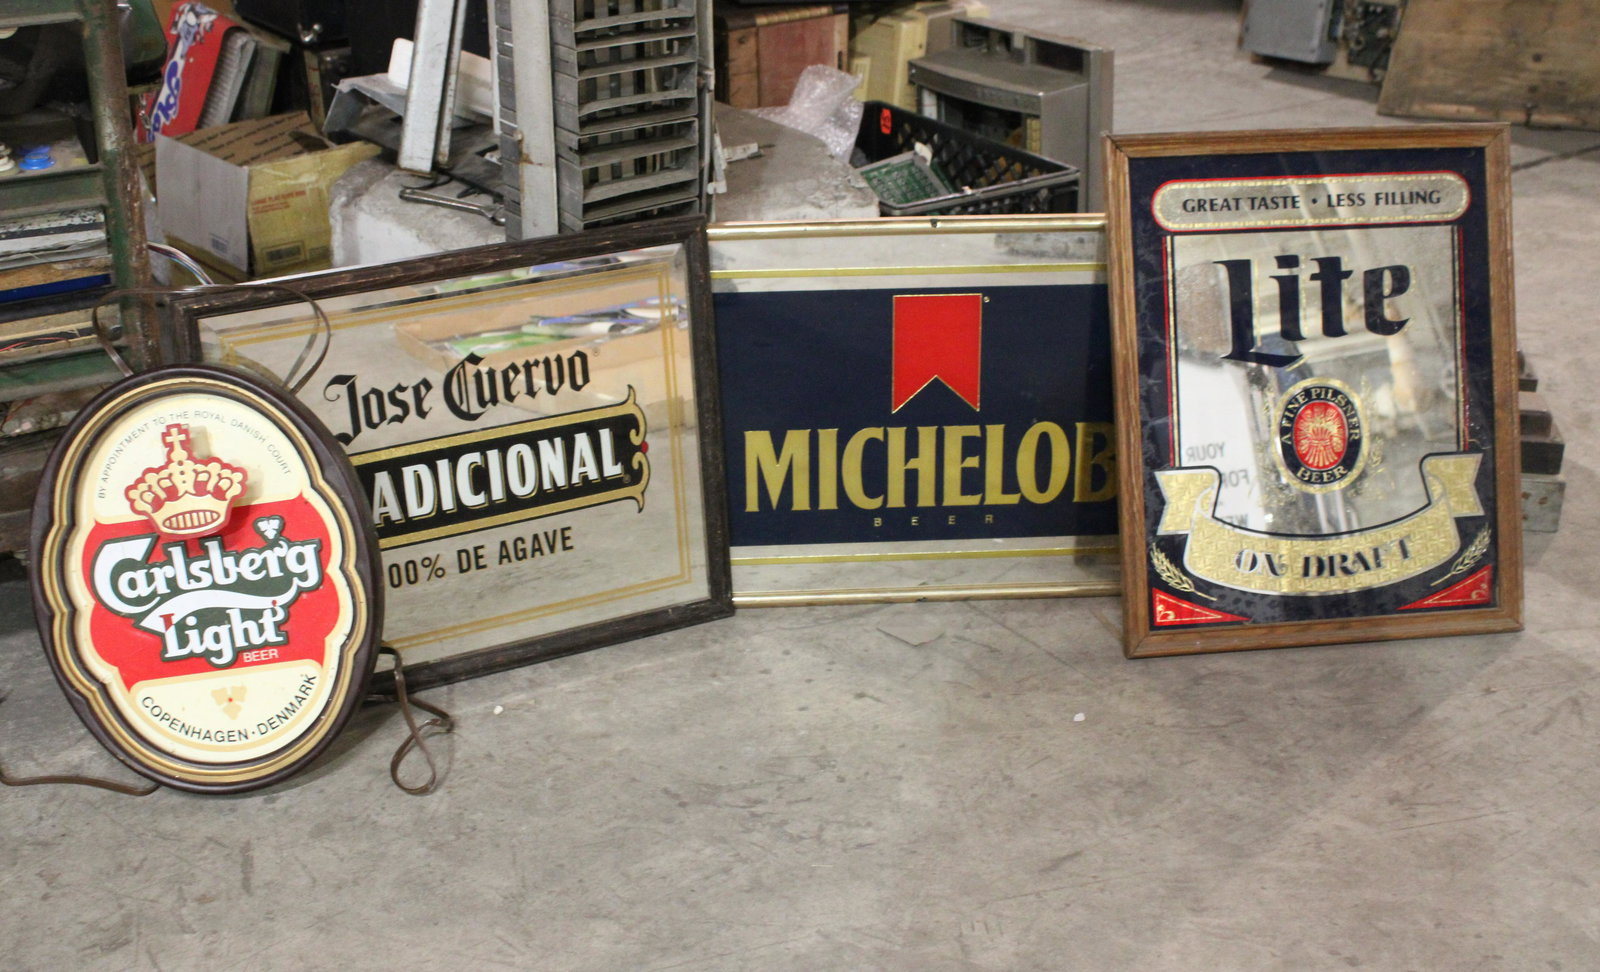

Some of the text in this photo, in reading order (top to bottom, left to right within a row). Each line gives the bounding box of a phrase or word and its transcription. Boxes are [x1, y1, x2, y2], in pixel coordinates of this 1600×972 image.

[1182, 190, 1442, 214] GREAT TASTE LESS FILLING
[1213, 254, 1416, 368] Lite
[324, 349, 591, 447] Jose Cuervo
[1282, 392, 1308, 427] FINE
[1310, 388, 1361, 442] PILSNER
[102, 422, 150, 482] APPOINTMENT
[153, 416, 167, 426] TO
[170, 411, 190, 421] THE
[194, 410, 226, 424] ROYAL
[230, 418, 267, 444] DANISH
[267, 443, 292, 475] COURT
[372, 427, 624, 527] ADICIONAL
[743, 421, 1117, 512] MICHELOB
[1296, 466, 1348, 483] BEER
[873, 514, 994, 527] BEER
[94, 536, 319, 616] Carlsberg
[388, 526, 574, 589] 00% DE AGAVE
[1235, 536, 1411, 578] ON DRAFT
[159, 602, 286, 667] Light
[243, 649, 279, 663] BEER
[142, 673, 317, 742] COPENHAGEN DENMARK
